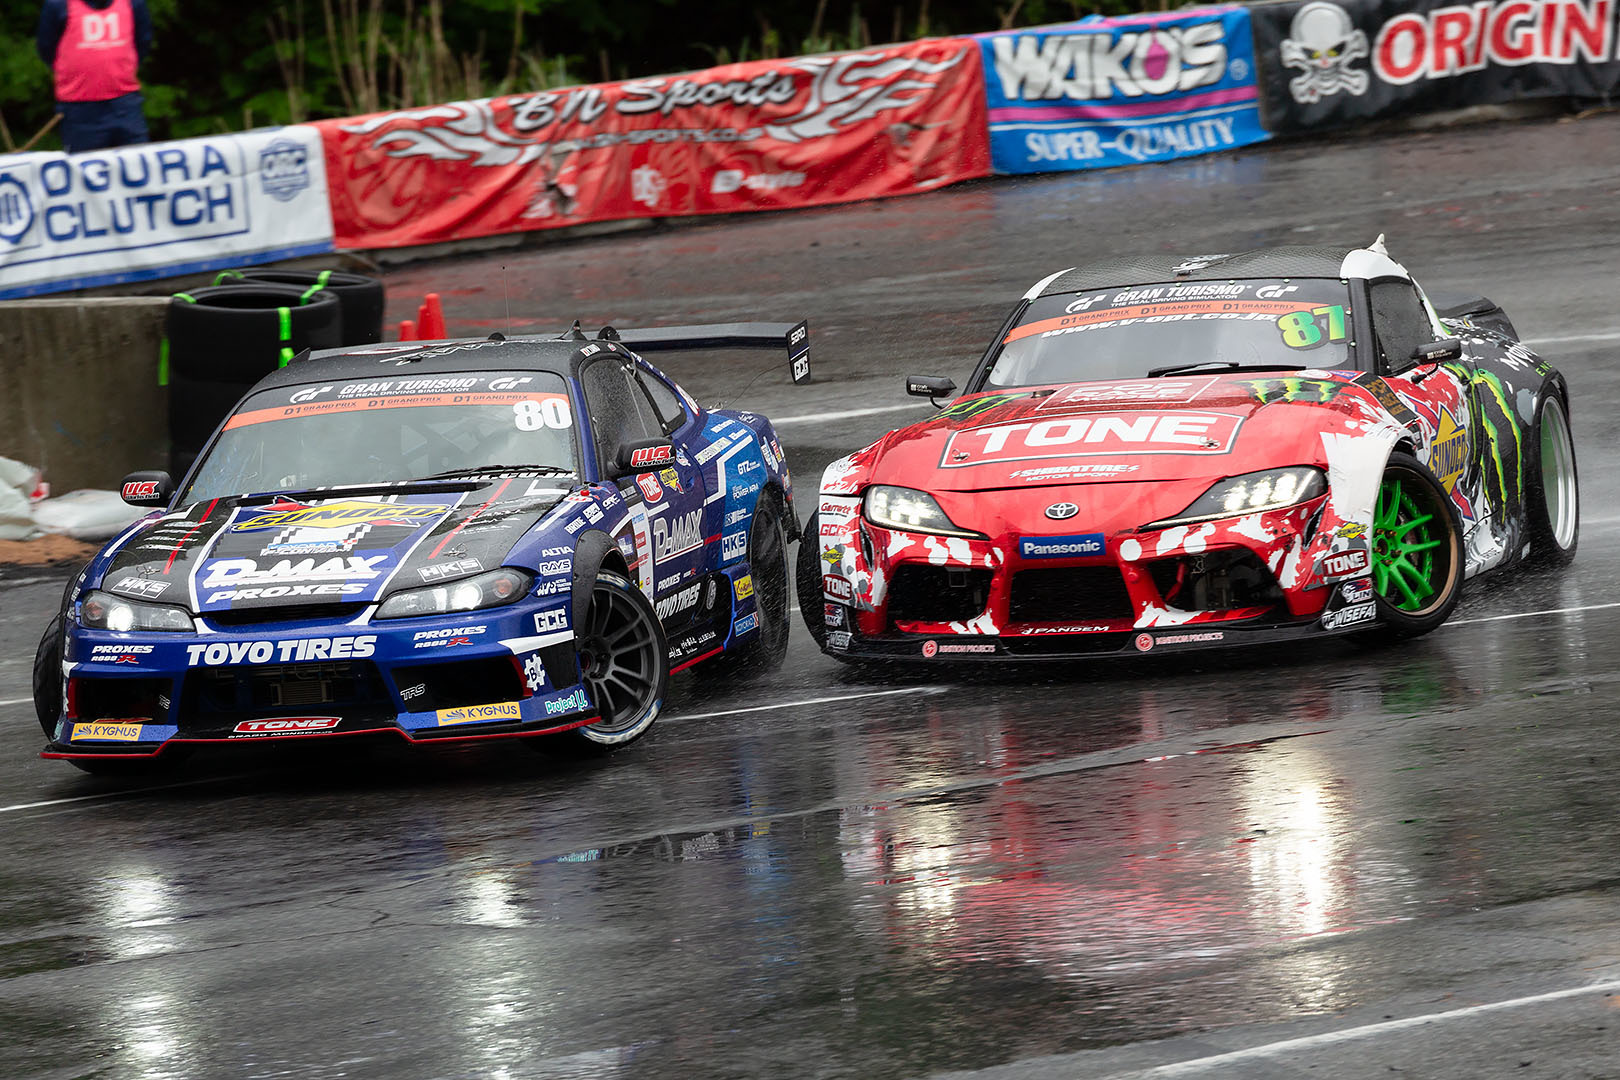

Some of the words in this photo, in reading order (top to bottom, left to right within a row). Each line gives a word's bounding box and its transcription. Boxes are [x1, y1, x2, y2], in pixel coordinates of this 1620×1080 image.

[82, 13, 120, 41] D1
[1373, 0, 1612, 85] ORIGIN
[615, 71, 798, 116] Sports
[1026, 117, 1234, 161] SUPER-QUALITY
[40, 146, 230, 196] OGURA
[45, 183, 236, 242] CLUTCH
[1112, 286, 1166, 303] GRAN
[1167, 284, 1244, 296] TURISMO
[1060, 316, 1077, 326] D1
[1079, 312, 1108, 321] GRAND
[1140, 307, 1157, 315] D1
[1277, 304, 1346, 348] 87
[340, 381, 395, 394] GRAN
[395, 378, 477, 391] TURISMO
[284, 408, 301, 416] D1
[303, 403, 334, 411] GRAND
[513, 398, 573, 431] 80
[976, 416, 1218, 455] TONE
[1431, 433, 1468, 477] SUNOCO
[237, 504, 449, 530] SUNOCO
[821, 502, 851, 514] Garrett
[654, 508, 703, 561] D-MAX
[723, 531, 747, 555] HKS
[1023, 540, 1101, 555] Panasonic
[205, 555, 388, 581] D-MAX
[420, 559, 481, 579] HKS
[540, 559, 572, 573] RAYS
[1324, 552, 1365, 574] TONE
[114, 576, 170, 596] HKS
[205, 583, 368, 603] PROXES
[825, 577, 850, 598] TONE
[675, 582, 701, 613] TIRES
[534, 609, 567, 633] GCG
[413, 626, 487, 641] PROXES
[92, 645, 155, 654] PROXES
[186, 641, 275, 667] TOYO
[278, 635, 377, 662] TIRES
[467, 705, 518, 718] KYGNUS
[545, 694, 577, 715] Project
[93, 726, 138, 736] KYGNUS
[248, 719, 332, 730] TONE
